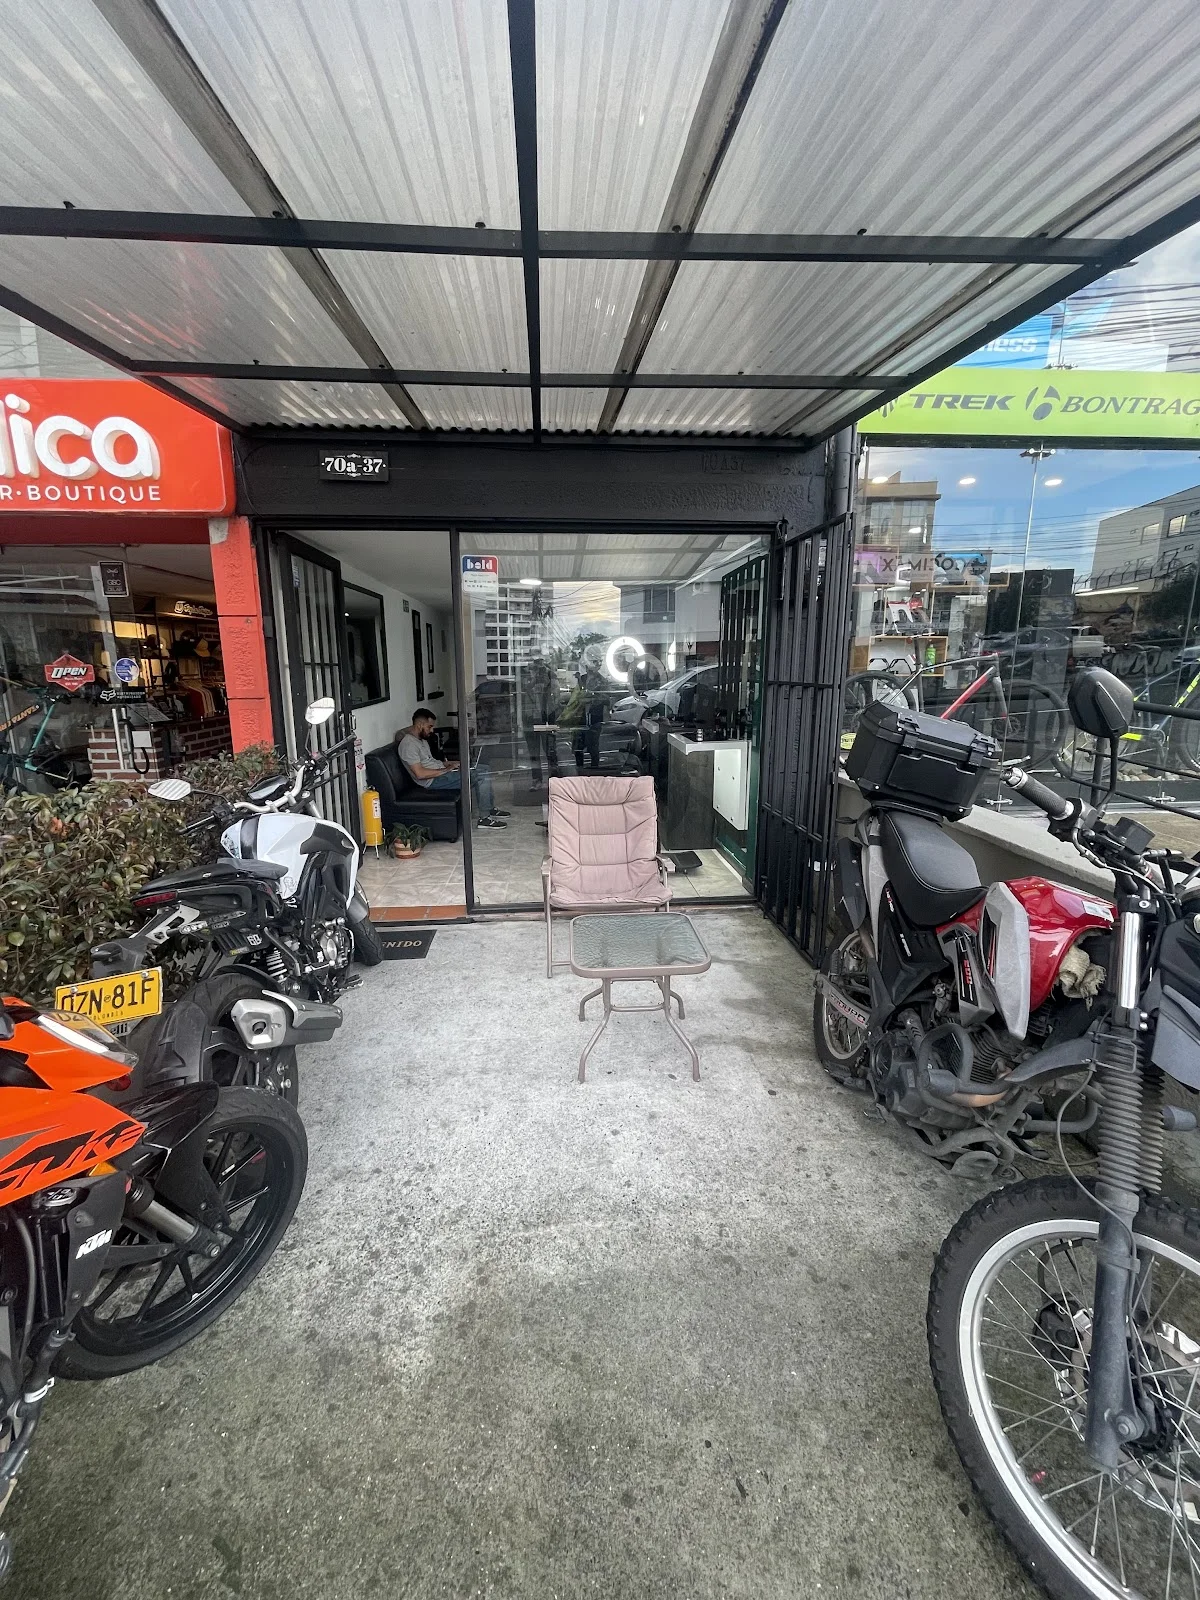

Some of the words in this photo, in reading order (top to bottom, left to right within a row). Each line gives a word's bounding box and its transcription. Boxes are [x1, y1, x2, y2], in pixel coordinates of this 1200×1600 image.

[909, 394, 1017, 411] TREK
[466, 559, 493, 570] bold
[51, 667, 87, 679] OPEN
[75, 1229, 113, 1260] KTM
